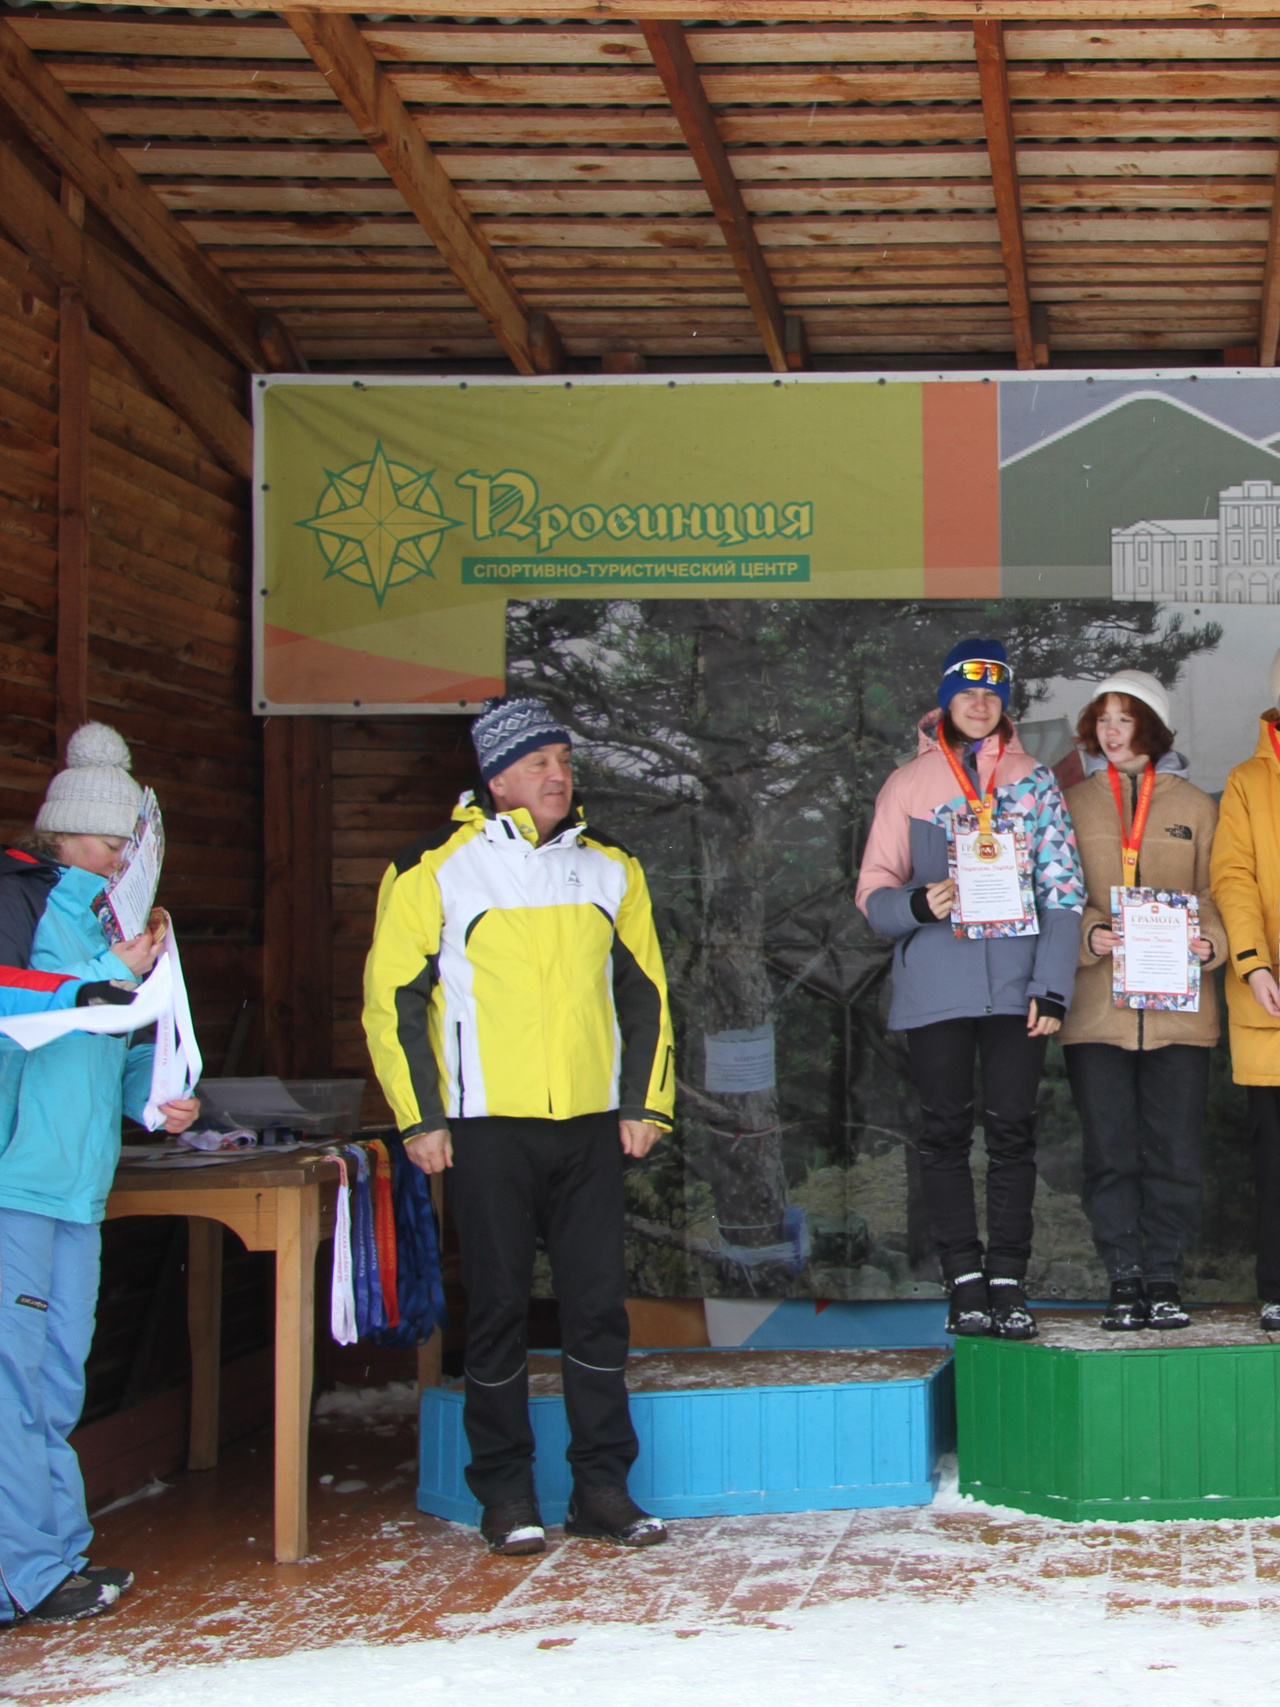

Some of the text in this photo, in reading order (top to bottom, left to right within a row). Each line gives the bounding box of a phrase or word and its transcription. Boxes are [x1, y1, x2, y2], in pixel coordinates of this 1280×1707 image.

[455, 469, 813, 553] Провинция
[473, 560, 798, 579] СПОРТИВНО-ТУРИСТИЧЕСКИЙ ЦЕНТР
[1131, 915, 1180, 925] ГРАМОТА
